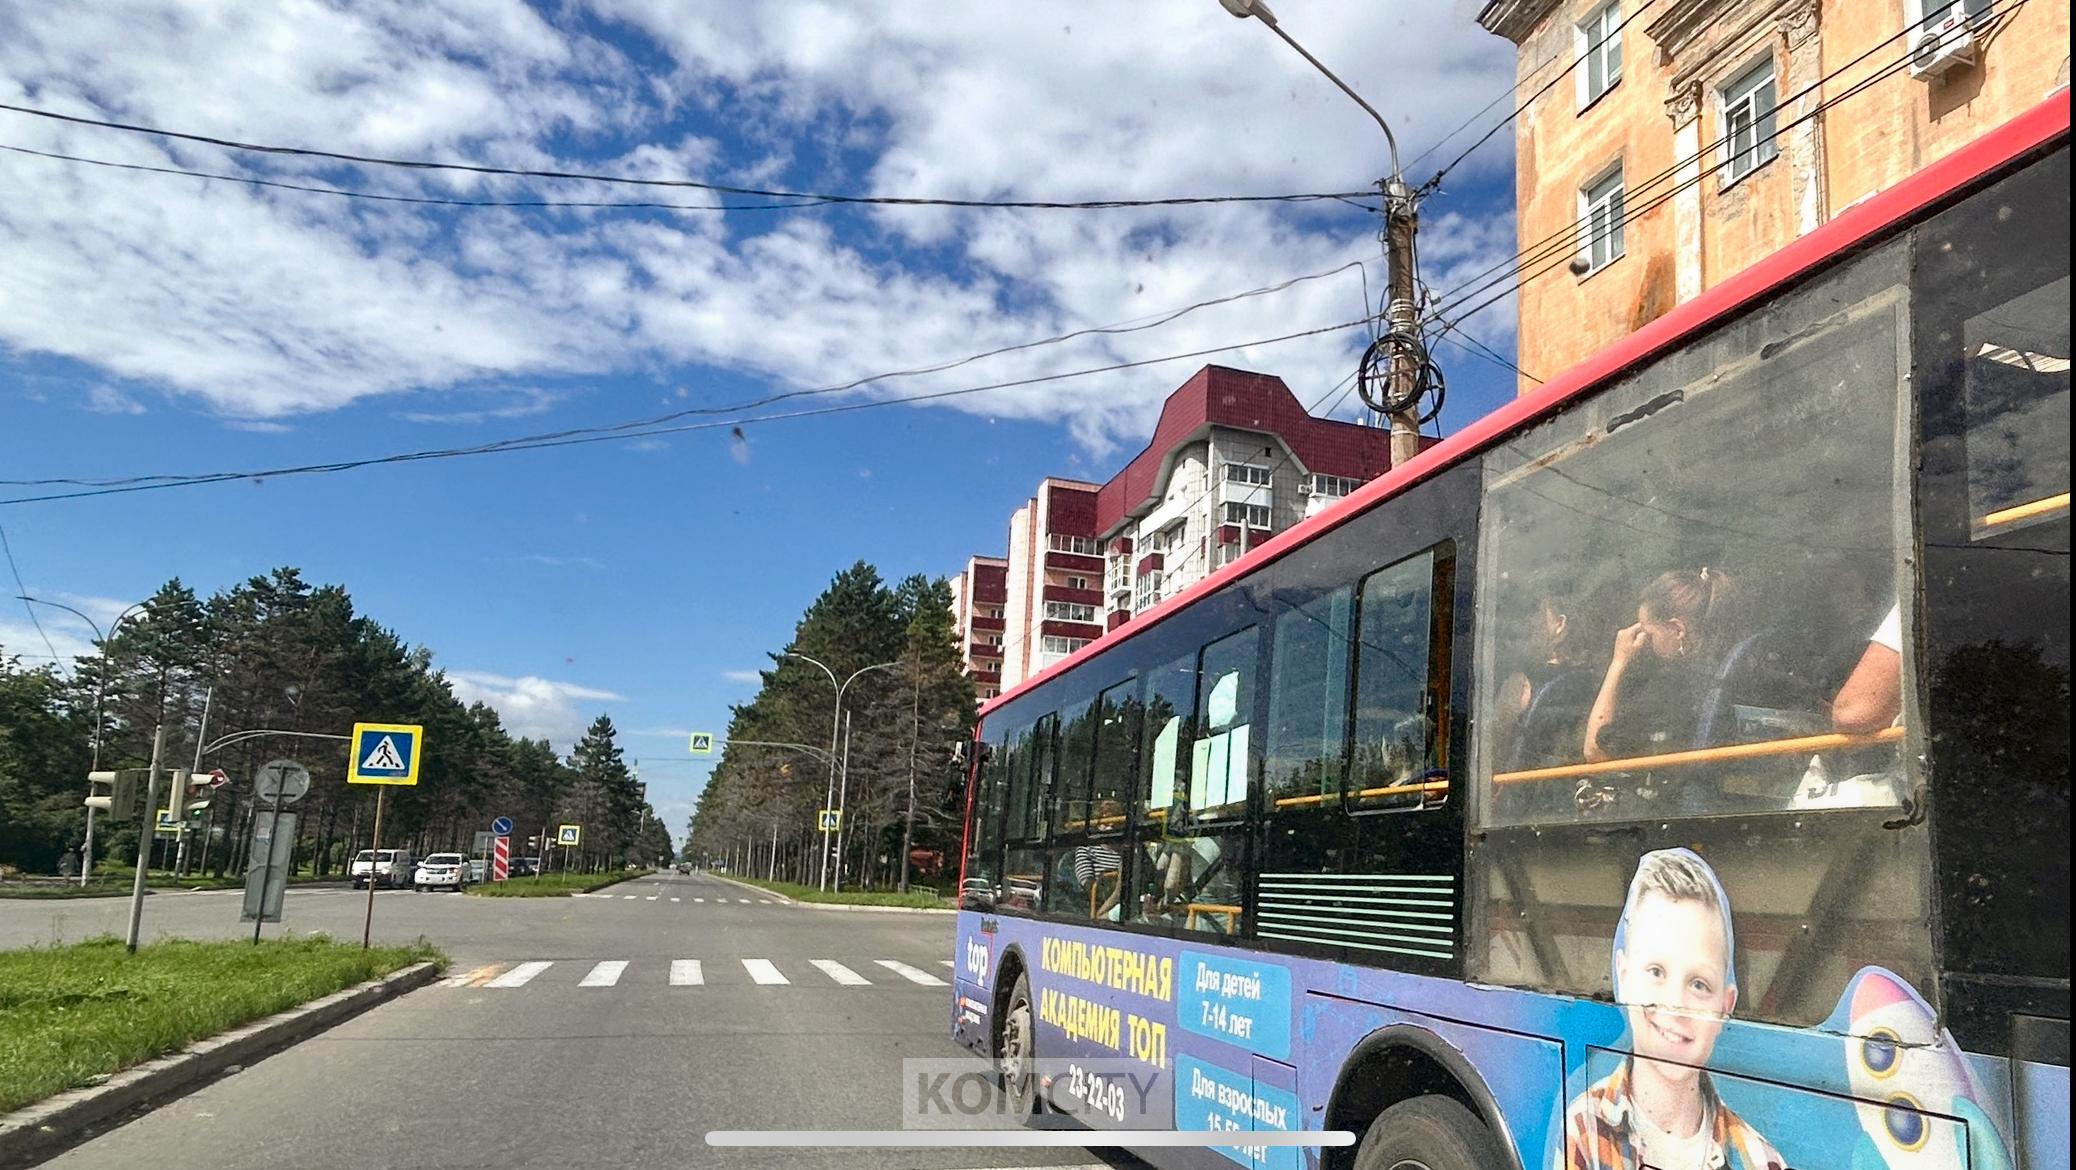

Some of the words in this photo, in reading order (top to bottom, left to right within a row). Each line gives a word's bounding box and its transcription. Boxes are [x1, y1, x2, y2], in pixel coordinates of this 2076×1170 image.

[967, 935, 989, 987] top
[1041, 936, 1173, 1003] КОМПЬЮТЕРНАЯ
[1195, 961, 1220, 993] Для
[1221, 971, 1261, 1000] детей
[1039, 986, 1121, 1051] АКАДЕМИЯ
[1127, 1013, 1167, 1070] ТОП
[1201, 1000, 1227, 1032] 7-14
[1228, 1014, 1253, 1040] лет
[1068, 1063, 1126, 1123] 23-22-03
[1191, 1067, 1216, 1100] Для
[1217, 1083, 1288, 1130] взрослых
